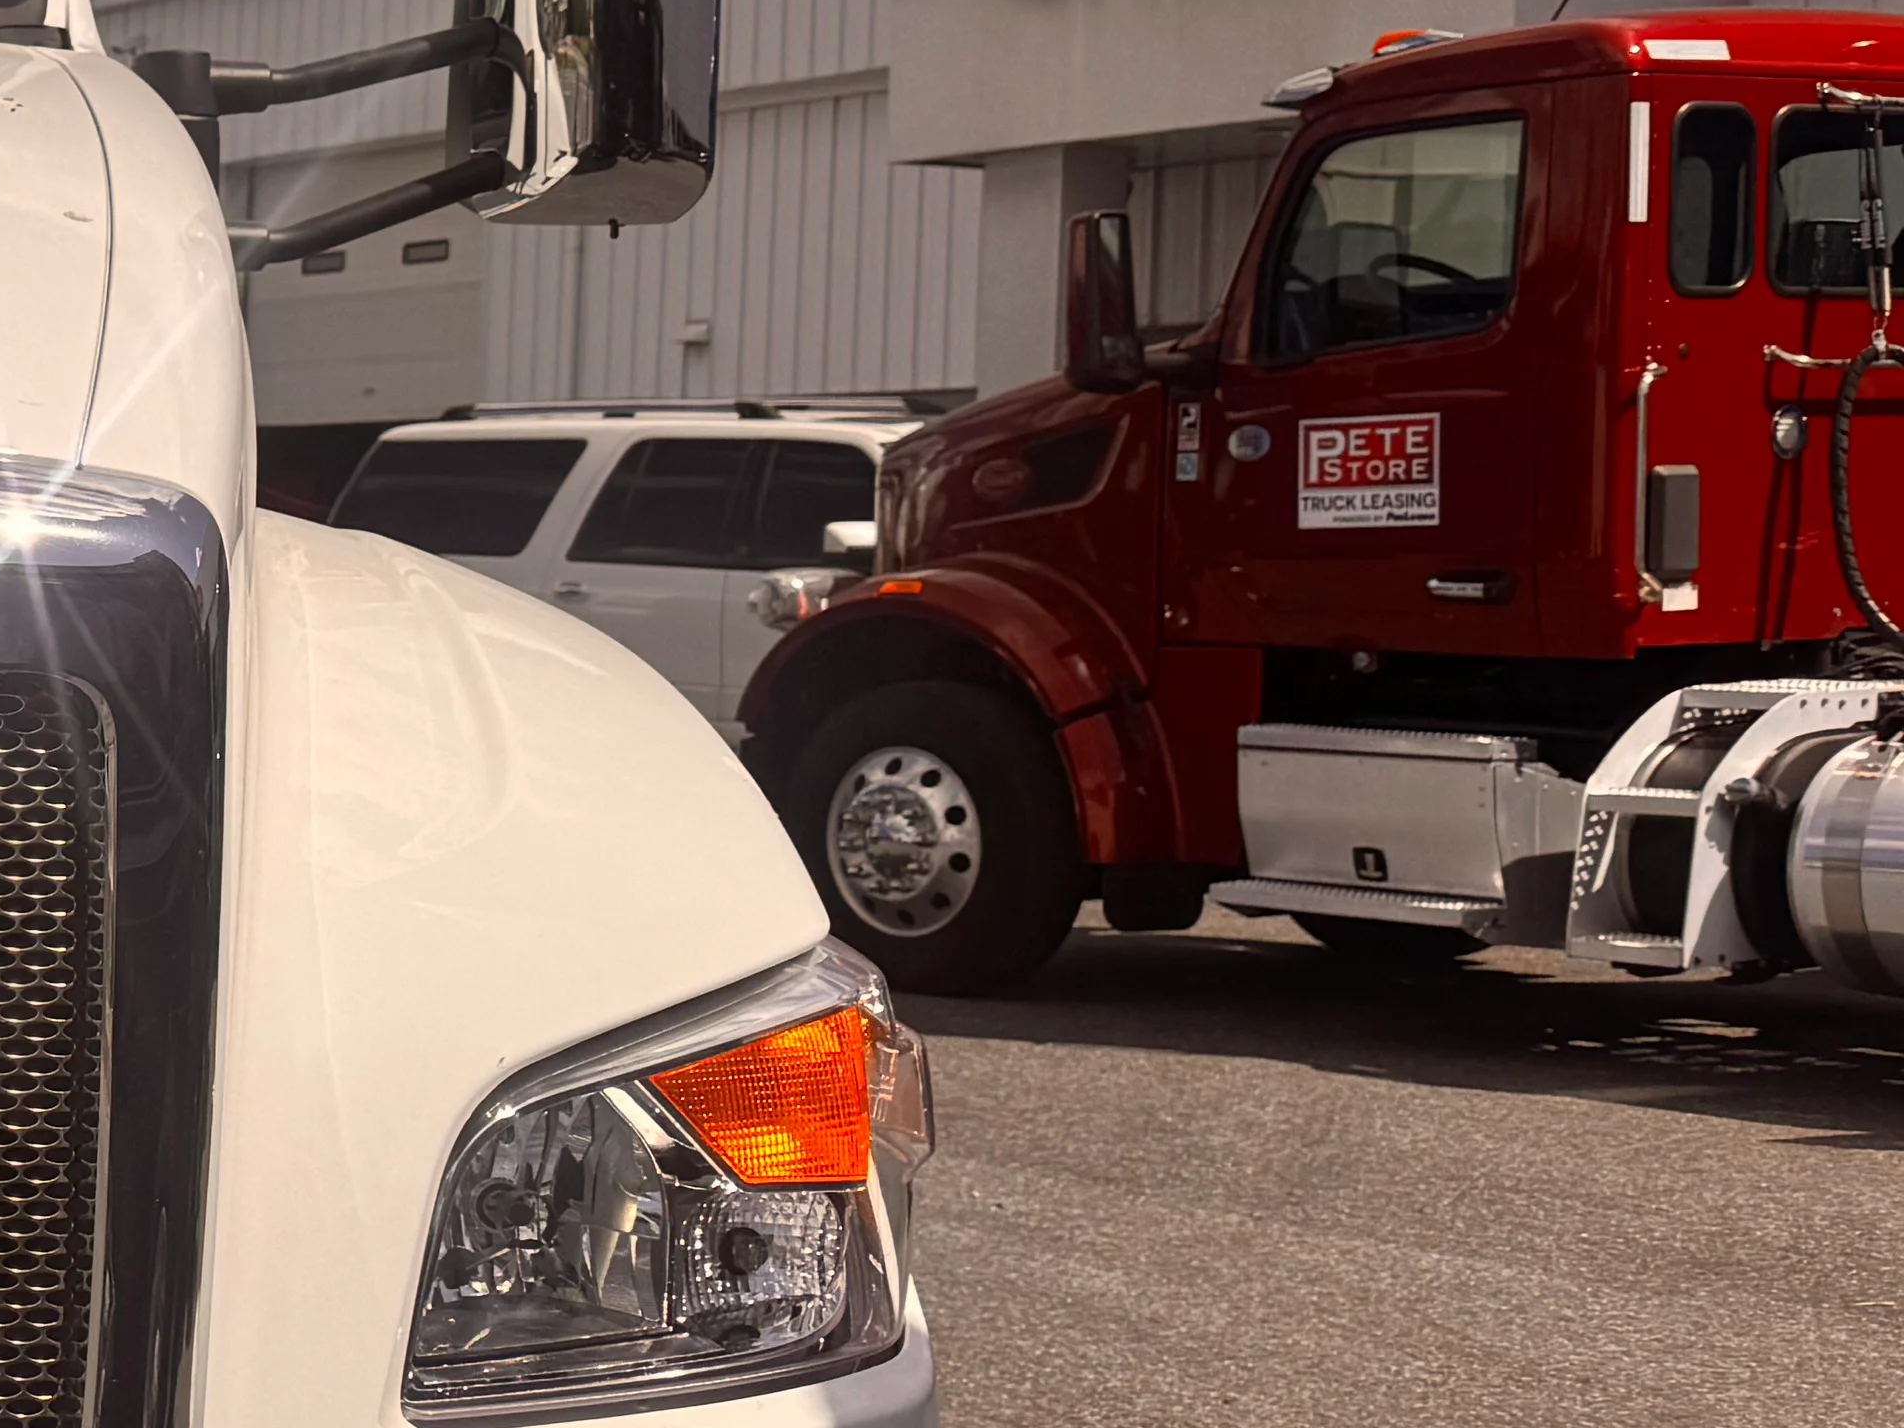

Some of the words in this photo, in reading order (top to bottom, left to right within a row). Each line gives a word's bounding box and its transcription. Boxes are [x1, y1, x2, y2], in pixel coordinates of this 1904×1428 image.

[1307, 425, 1431, 483] PETE
[1323, 457, 1430, 483] STORE
[1301, 494, 1357, 512] TRUCK
[1360, 491, 1437, 510] LEASING
